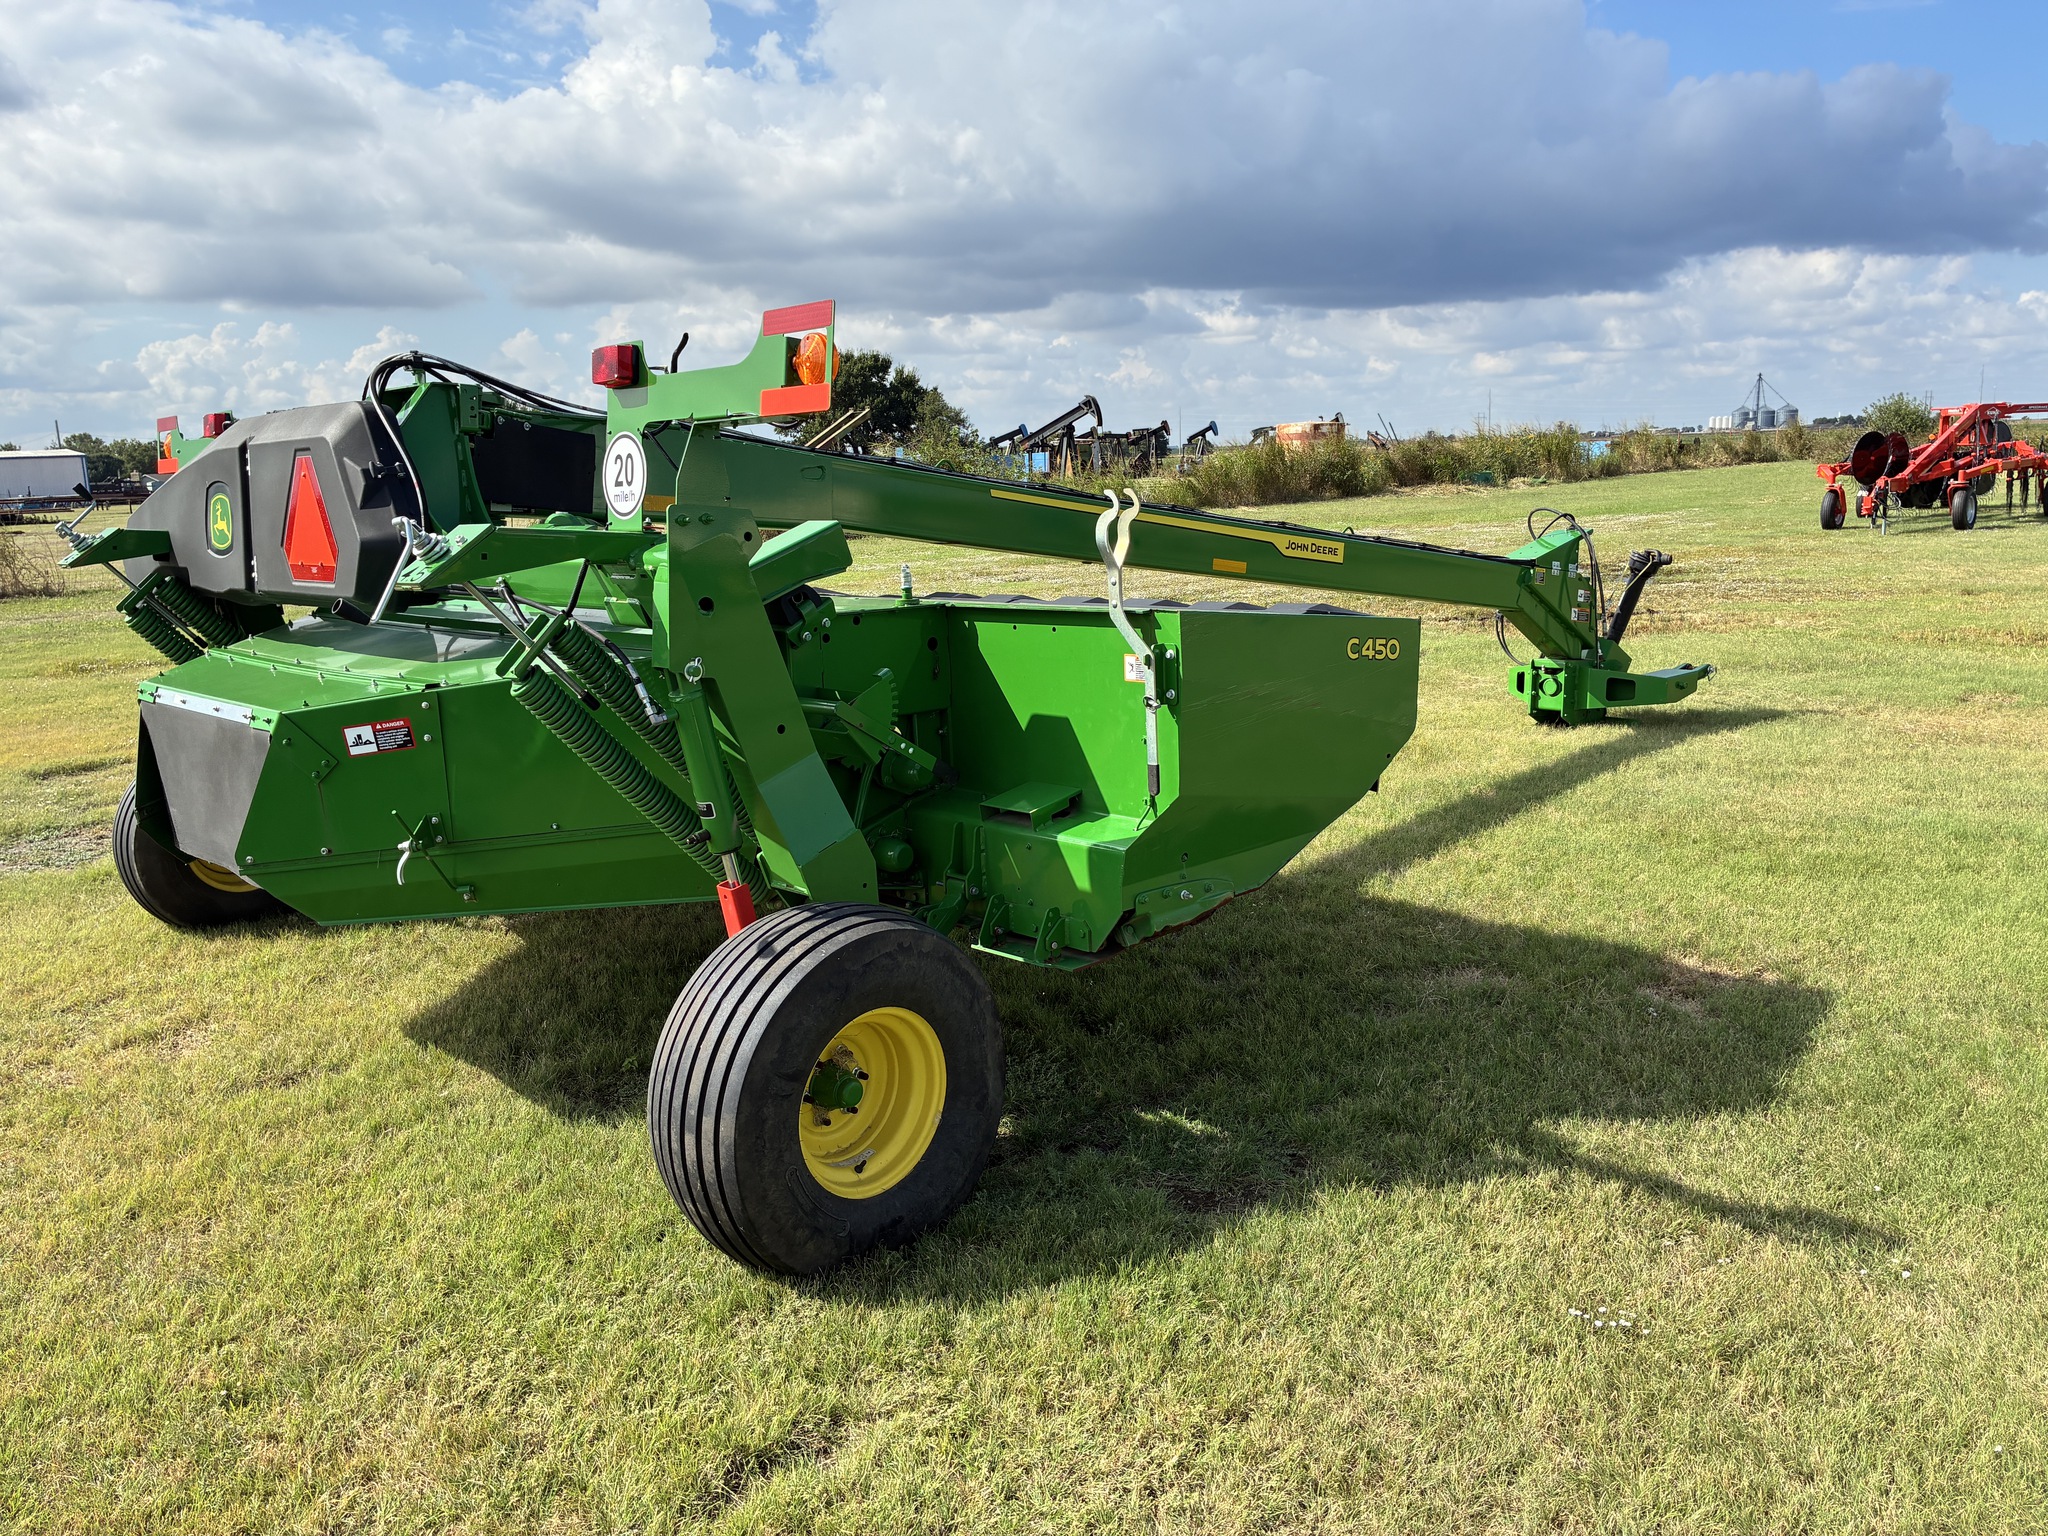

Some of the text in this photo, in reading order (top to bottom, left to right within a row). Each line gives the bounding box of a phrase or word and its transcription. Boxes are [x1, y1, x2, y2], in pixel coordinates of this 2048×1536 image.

[614, 453, 634, 487] 20
[613, 490, 636, 502] mile/h
[1285, 540, 1339, 556] JOHN DEERE
[381, 720, 405, 728] DANGER
